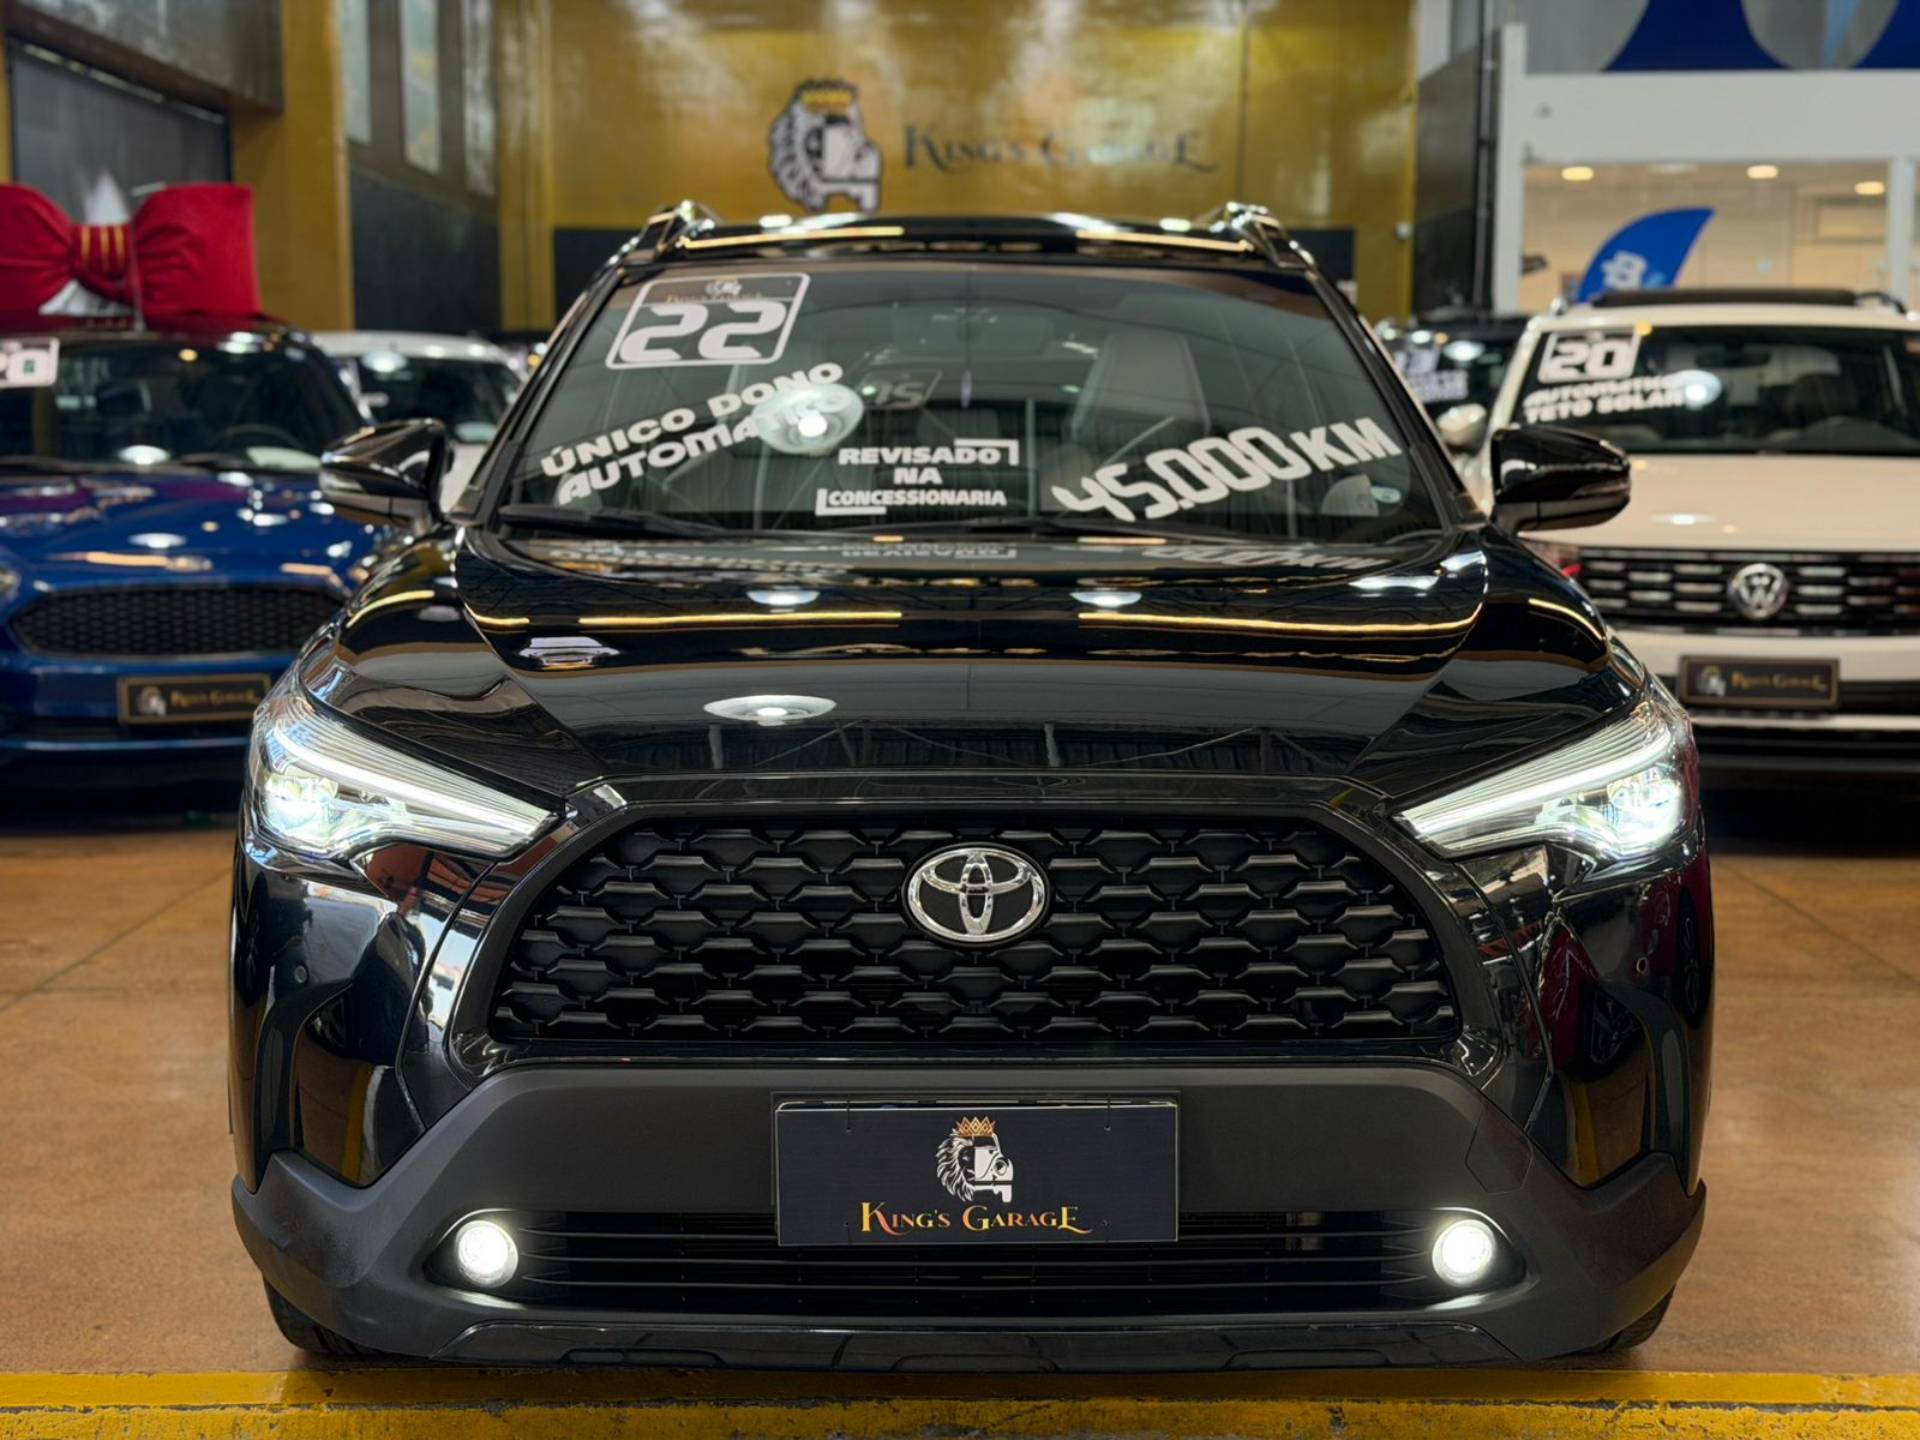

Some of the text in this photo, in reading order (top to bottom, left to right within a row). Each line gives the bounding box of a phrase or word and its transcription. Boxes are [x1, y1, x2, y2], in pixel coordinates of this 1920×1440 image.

[619, 301, 787, 363] 22
[1553, 339, 1634, 378] 20
[540, 362, 843, 477] ÚNICO DONO
[838, 446, 1001, 465] REVISADO
[893, 467, 943, 484] NA
[828, 490, 1007, 506] CONCESSIONARIA
